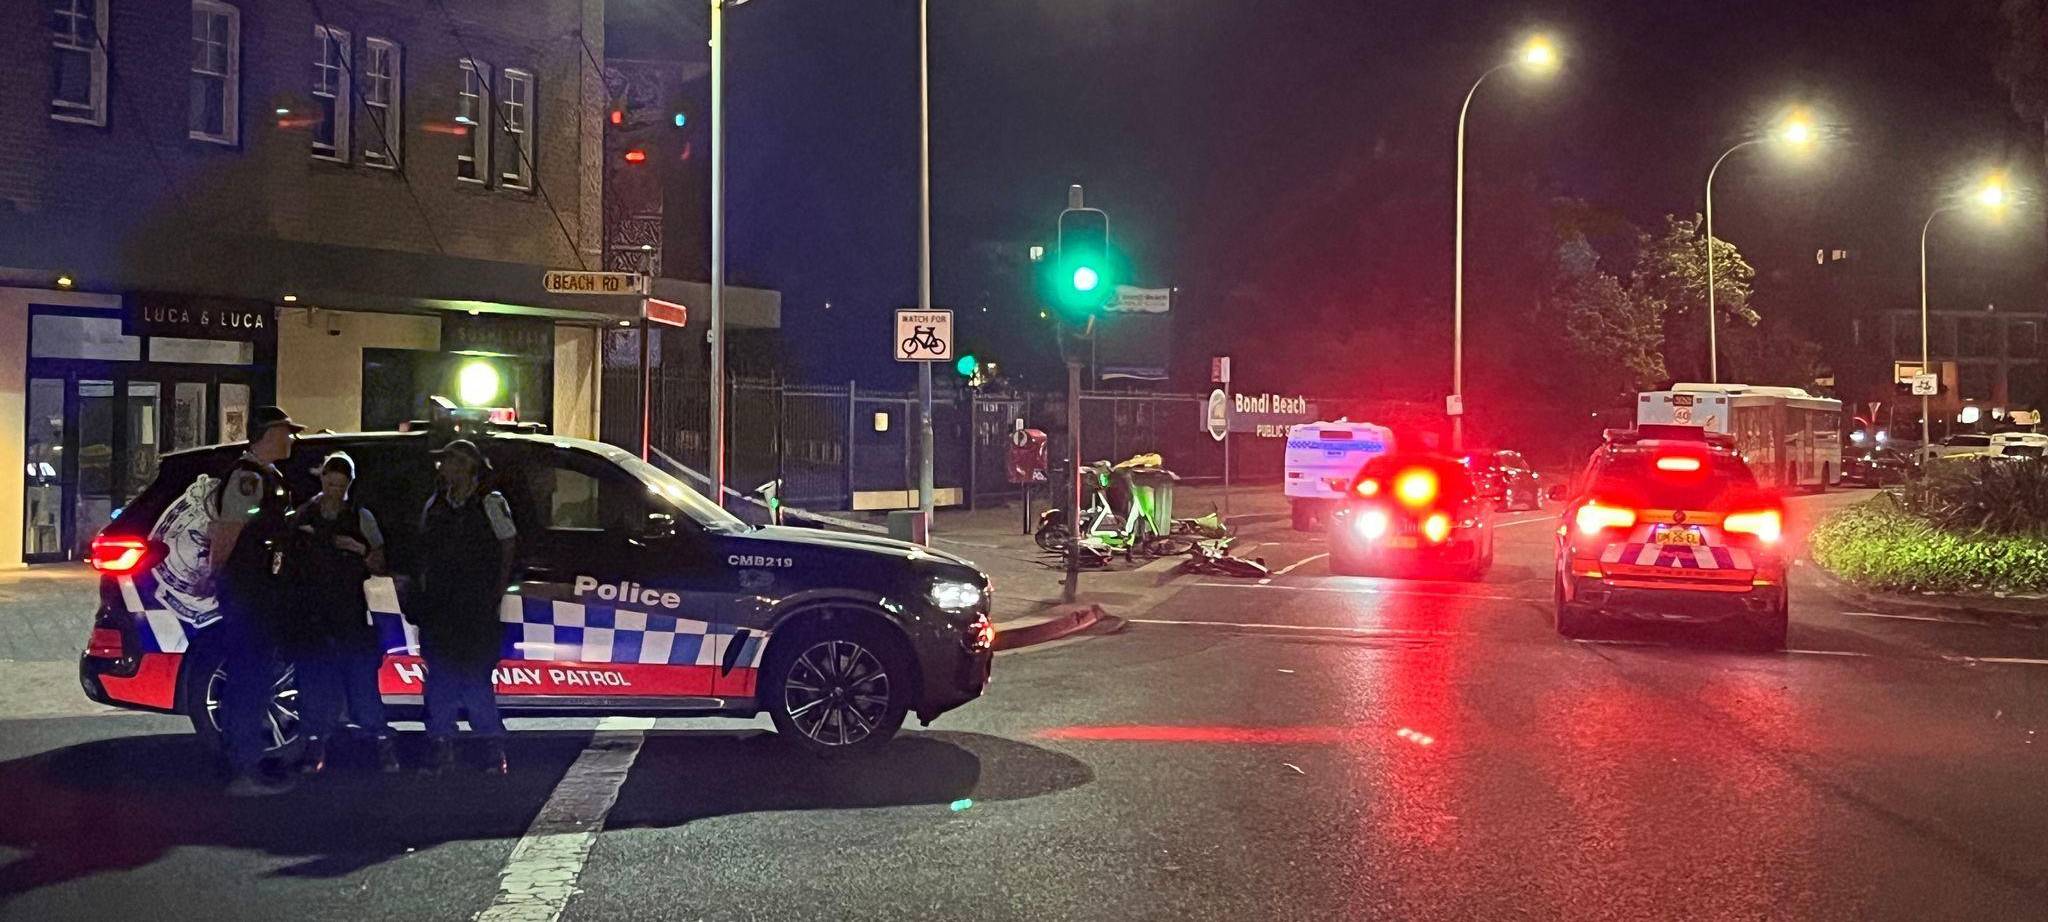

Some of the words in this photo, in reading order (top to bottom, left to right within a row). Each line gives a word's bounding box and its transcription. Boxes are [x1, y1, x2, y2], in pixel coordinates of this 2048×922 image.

[553, 273, 595, 291] BEACH
[602, 277, 619, 292] RD
[144, 306, 190, 323] LUCA
[200, 310, 210, 325] &
[221, 312, 264, 328] LUCA
[902, 315, 929, 323] WATCH
[931, 315, 946, 323] FOR
[1235, 393, 1269, 413] Bondi
[1272, 395, 1306, 414] Beach
[1677, 411, 1689, 420] 40
[1256, 425, 1284, 437] PUBLIC
[573, 575, 681, 609] Police
[548, 669, 631, 686] PATROL
